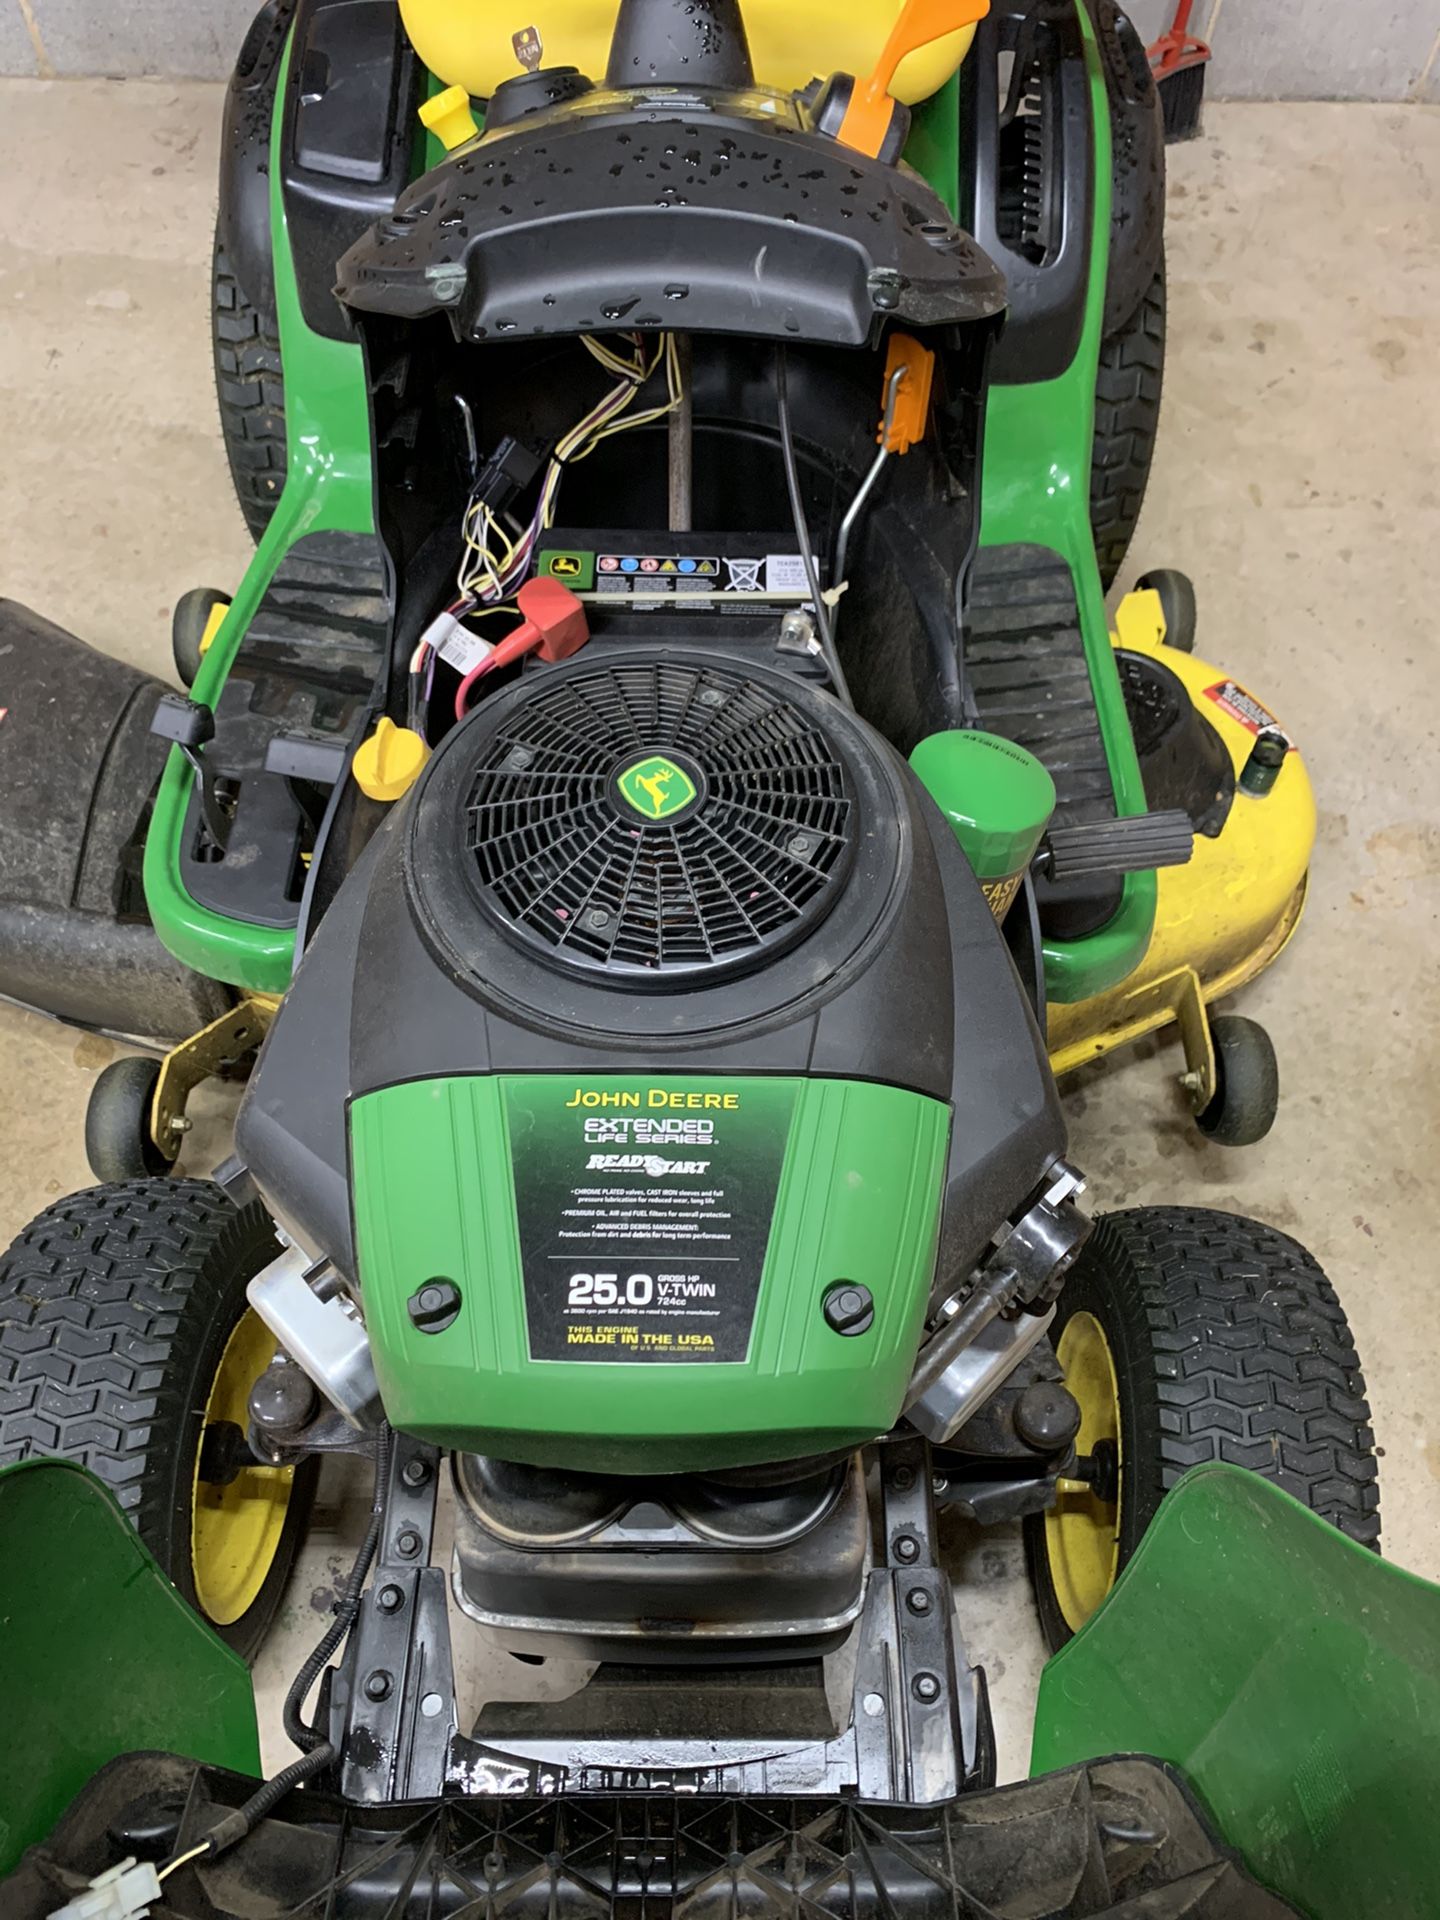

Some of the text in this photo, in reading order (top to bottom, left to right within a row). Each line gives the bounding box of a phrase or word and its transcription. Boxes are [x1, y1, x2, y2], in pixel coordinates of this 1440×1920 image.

[566, 1089, 739, 1109] JOHN DEERE
[584, 1118, 714, 1133] EXTENDED
[584, 1133, 628, 1143] LIFE
[690, 1198, 704, 1206] long
[699, 1211, 731, 1219] protection
[558, 1230, 591, 1238] Protection
[662, 1232, 676, 1240] long
[692, 1232, 731, 1240] performance
[658, 1274, 686, 1282] GROSS
[568, 1274, 653, 1305] 25.0
[658, 1283, 716, 1297] V-TWIN
[657, 1297, 687, 1306] 724cc
[597, 1326, 639, 1334] ENGINE
[567, 1333, 714, 1345] MADE IN THE USA
